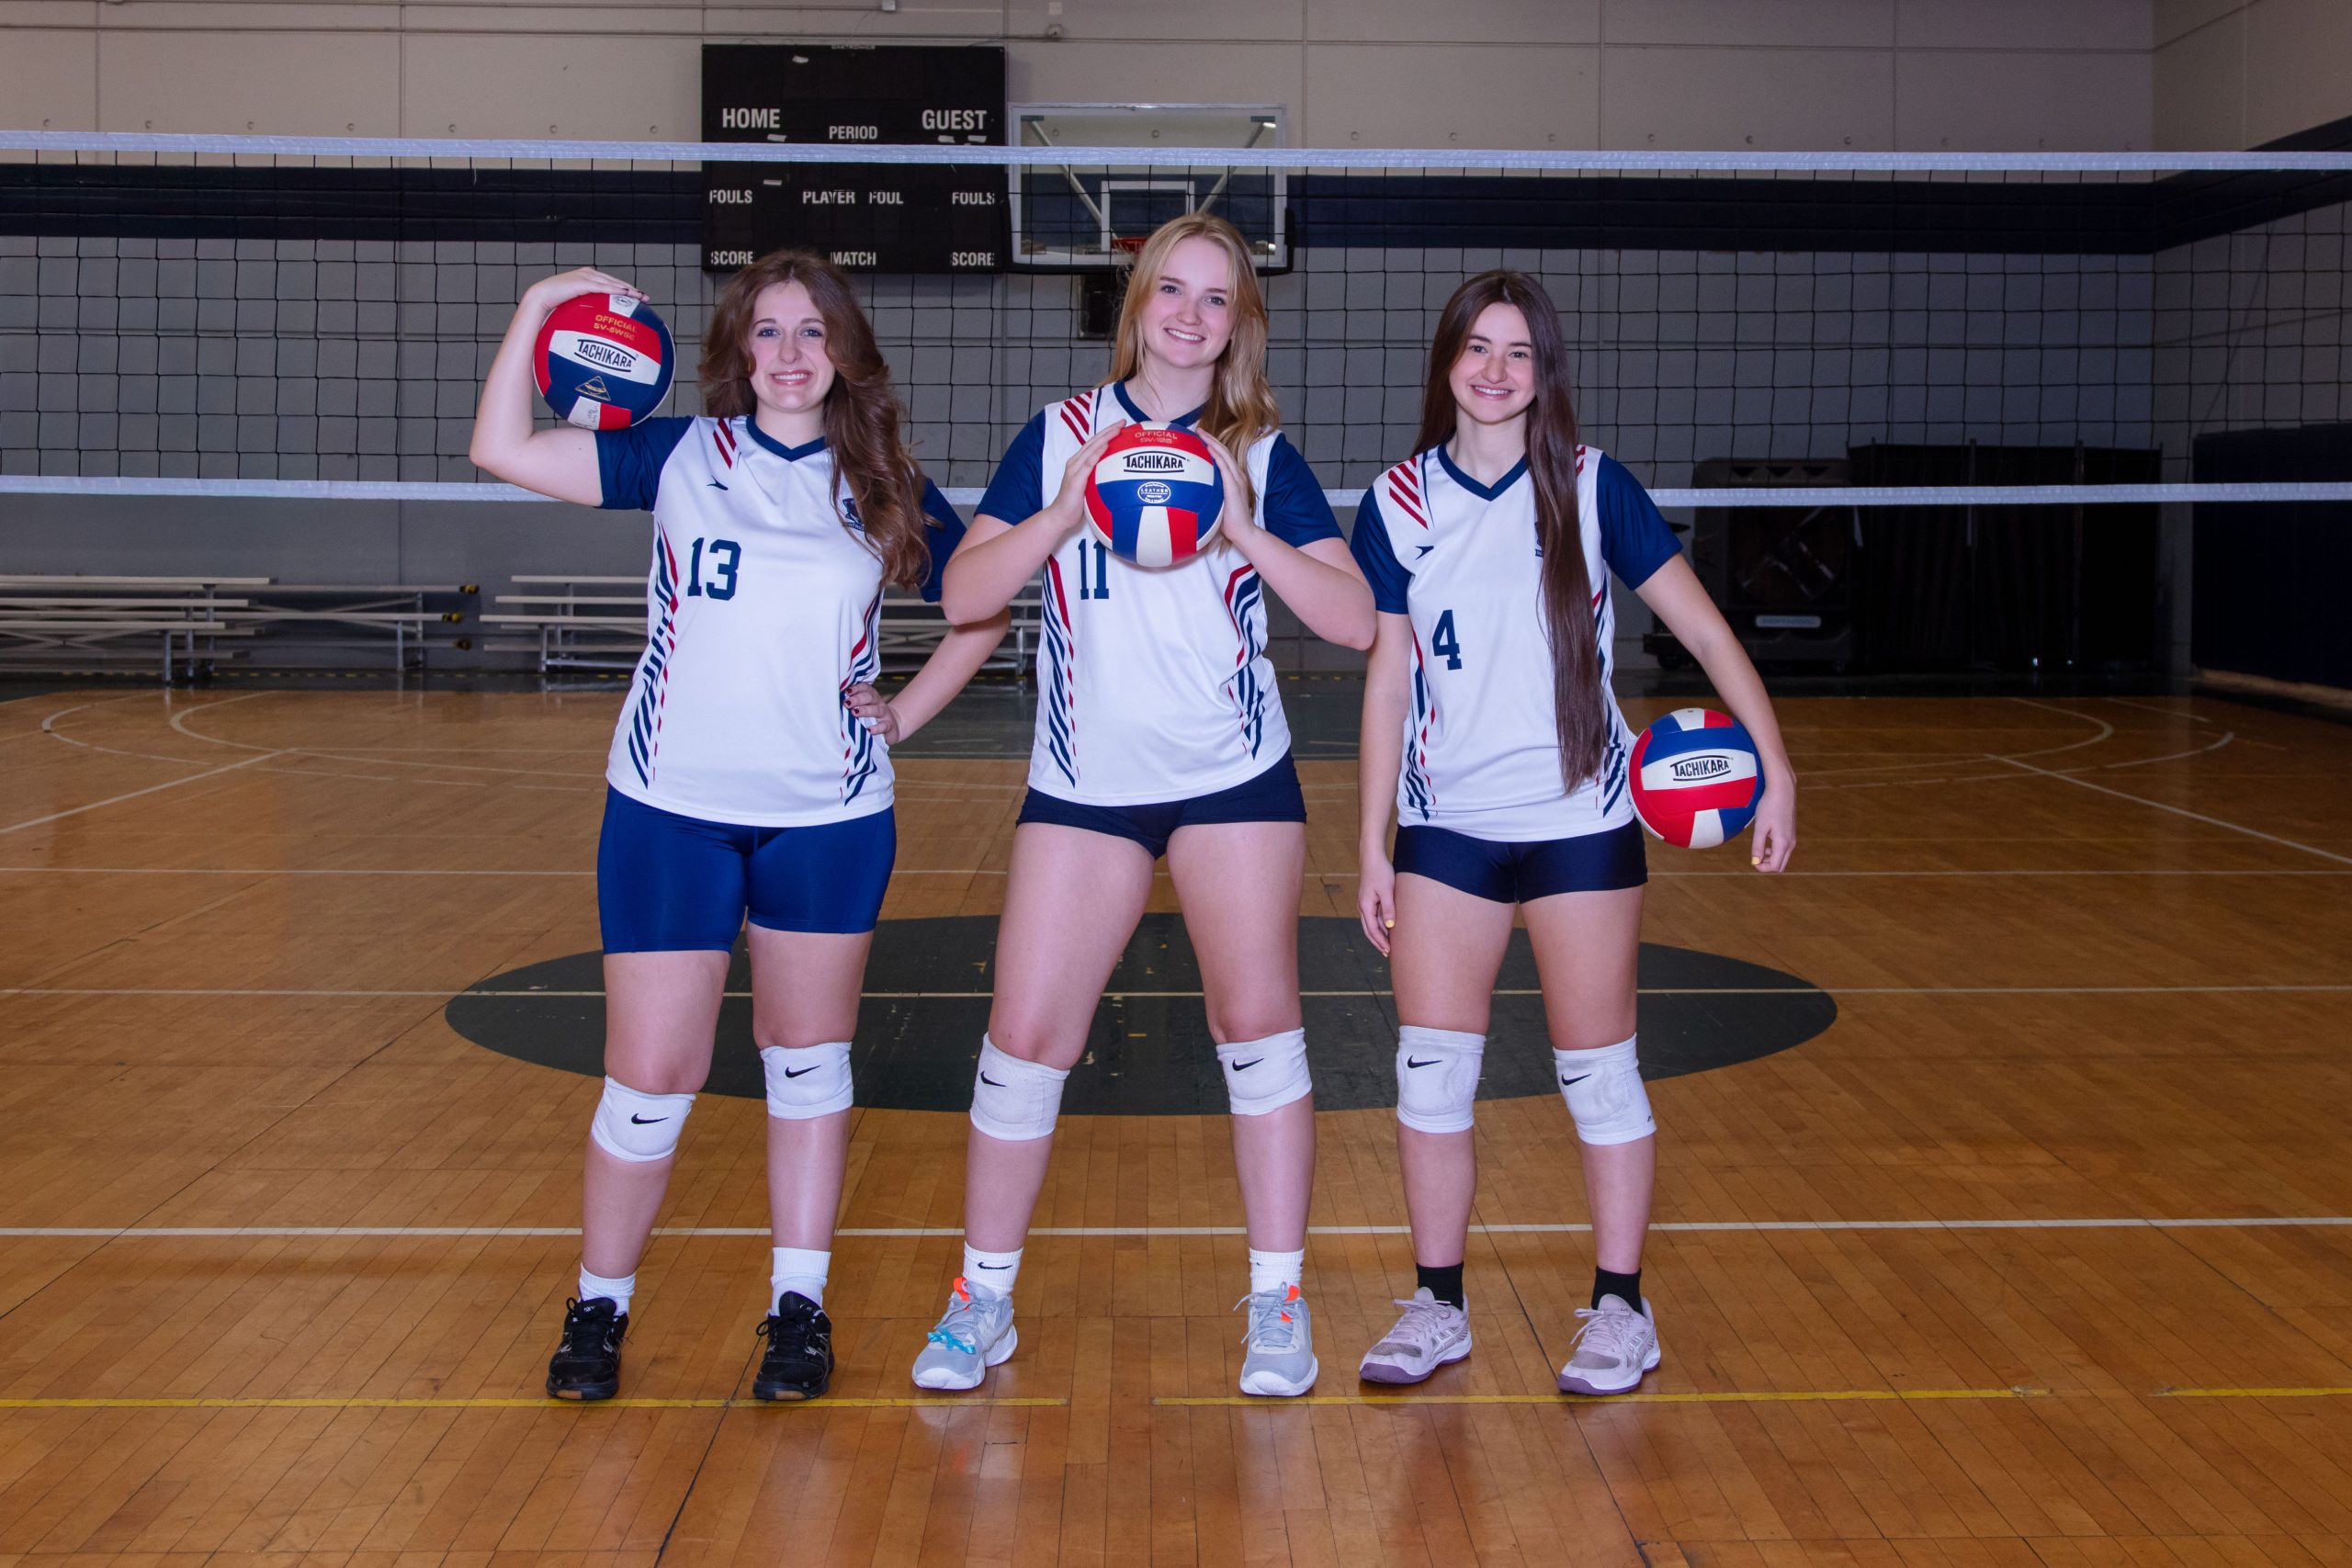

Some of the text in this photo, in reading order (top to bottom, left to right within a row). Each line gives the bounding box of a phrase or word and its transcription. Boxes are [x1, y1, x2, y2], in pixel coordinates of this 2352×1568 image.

[722, 107, 781, 129] HOME
[922, 109, 988, 130] GUEST
[829, 125, 878, 140] PERIOD
[709, 189, 753, 204] FOULS
[803, 189, 904, 205] PLAYER FOUL
[952, 191, 995, 205] FOULS
[710, 250, 753, 265] SCORE
[831, 251, 876, 265] MATCH
[950, 252, 995, 266] SCORE
[594, 314, 637, 333] OFFICIAL
[577, 339, 632, 368] TACHIKARA
[1135, 431, 1179, 440] OFFICIAL
[1123, 454, 1184, 469] TACHIKARA
[687, 536, 742, 602] 13
[1078, 538, 1110, 600] 11
[1431, 609, 1463, 671] 4
[1670, 758, 1730, 777] TACHIKARA
